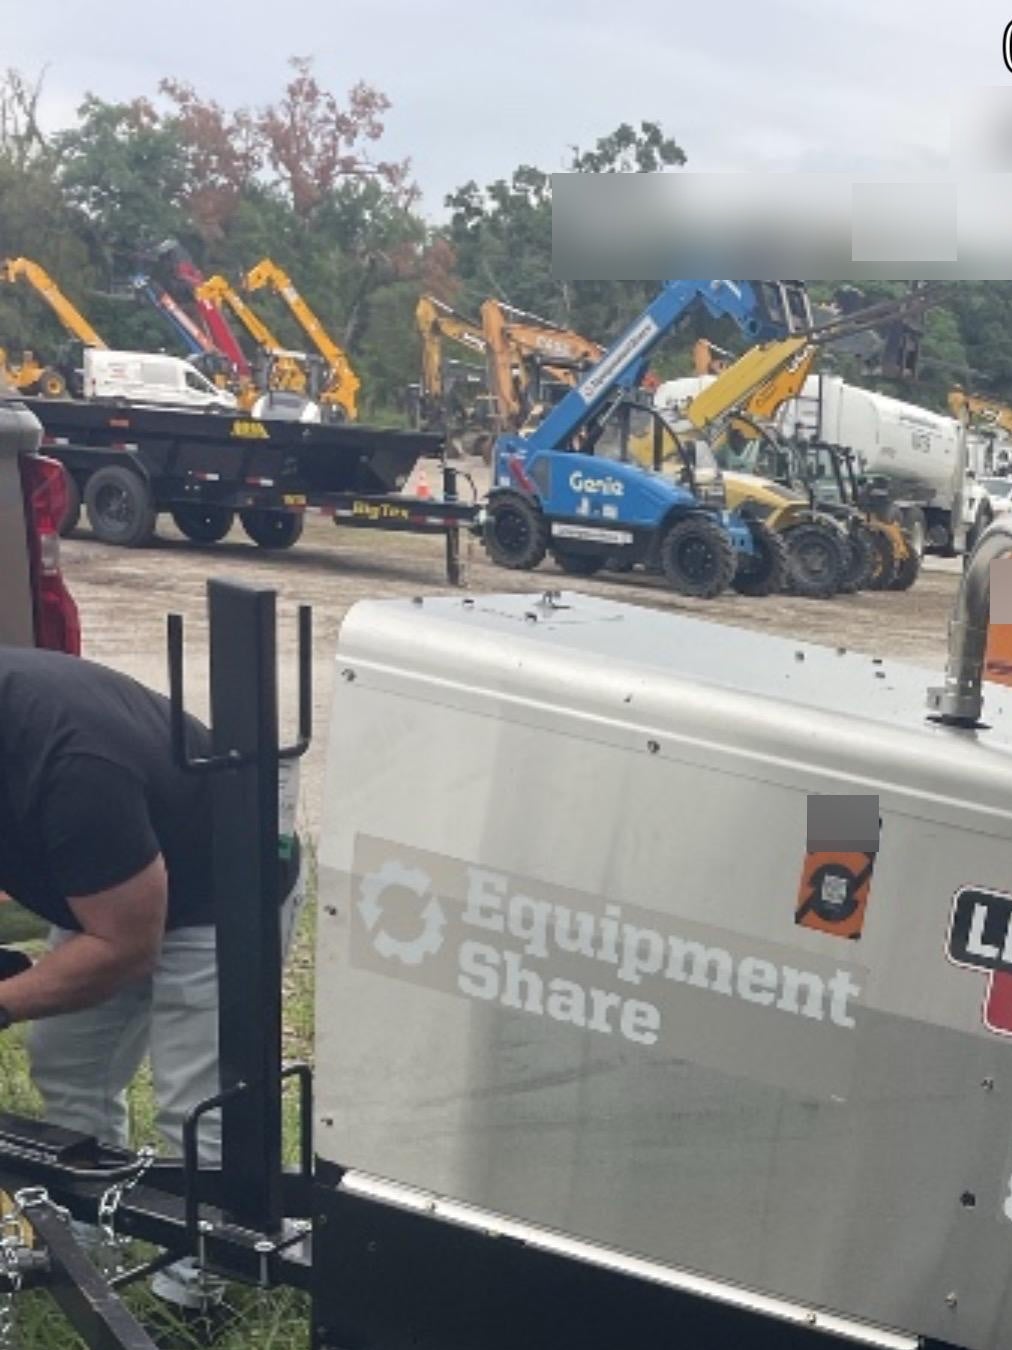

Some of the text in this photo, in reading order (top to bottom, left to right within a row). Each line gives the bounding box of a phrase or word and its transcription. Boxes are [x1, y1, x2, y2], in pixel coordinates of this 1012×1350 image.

[569, 469, 624, 496] Genie
[456, 940, 662, 1046] Share
[460, 865, 862, 1029] Equipment
